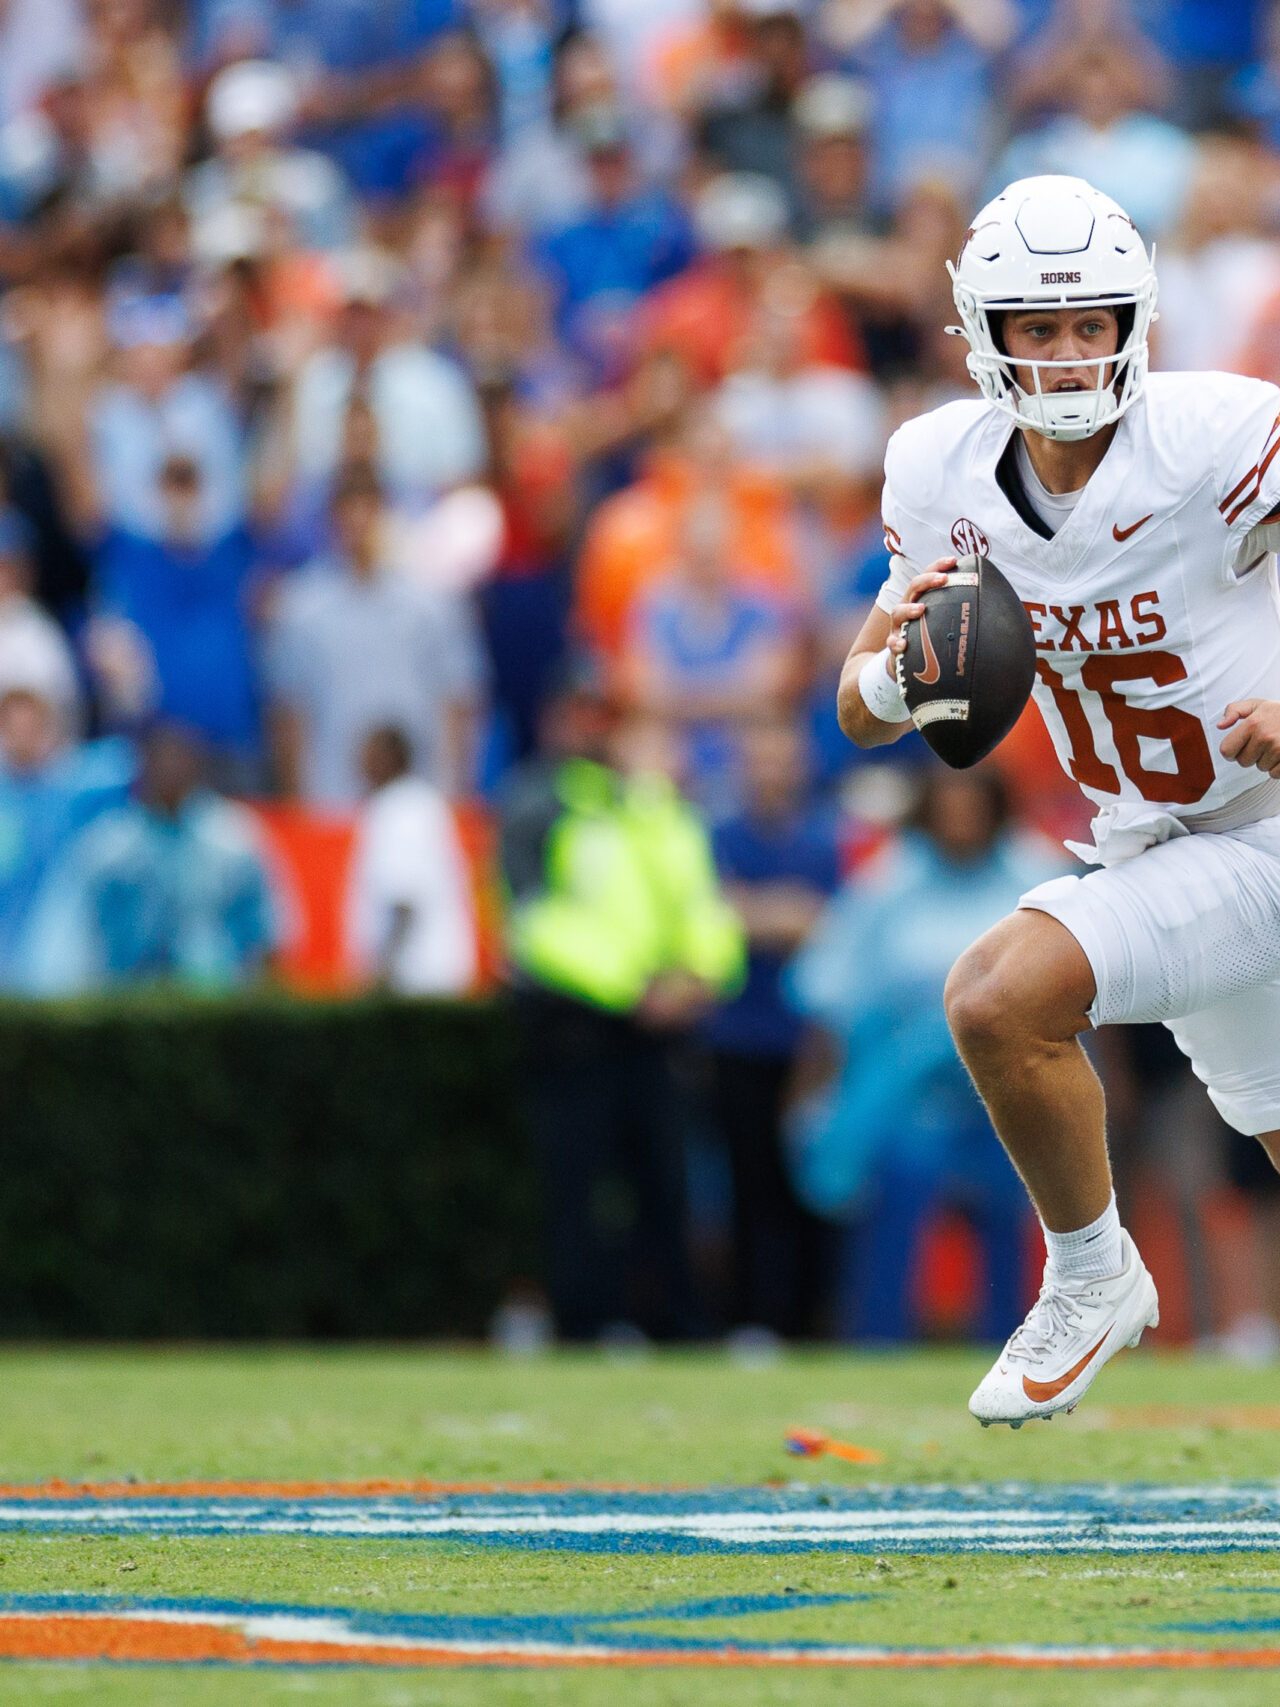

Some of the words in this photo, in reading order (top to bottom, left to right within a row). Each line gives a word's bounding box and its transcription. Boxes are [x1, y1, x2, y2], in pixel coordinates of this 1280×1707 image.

[1040, 271, 1081, 284] HORNS
[951, 518, 989, 557] SEC
[1021, 590, 1167, 651] EXAS
[1036, 650, 1215, 804] 16
